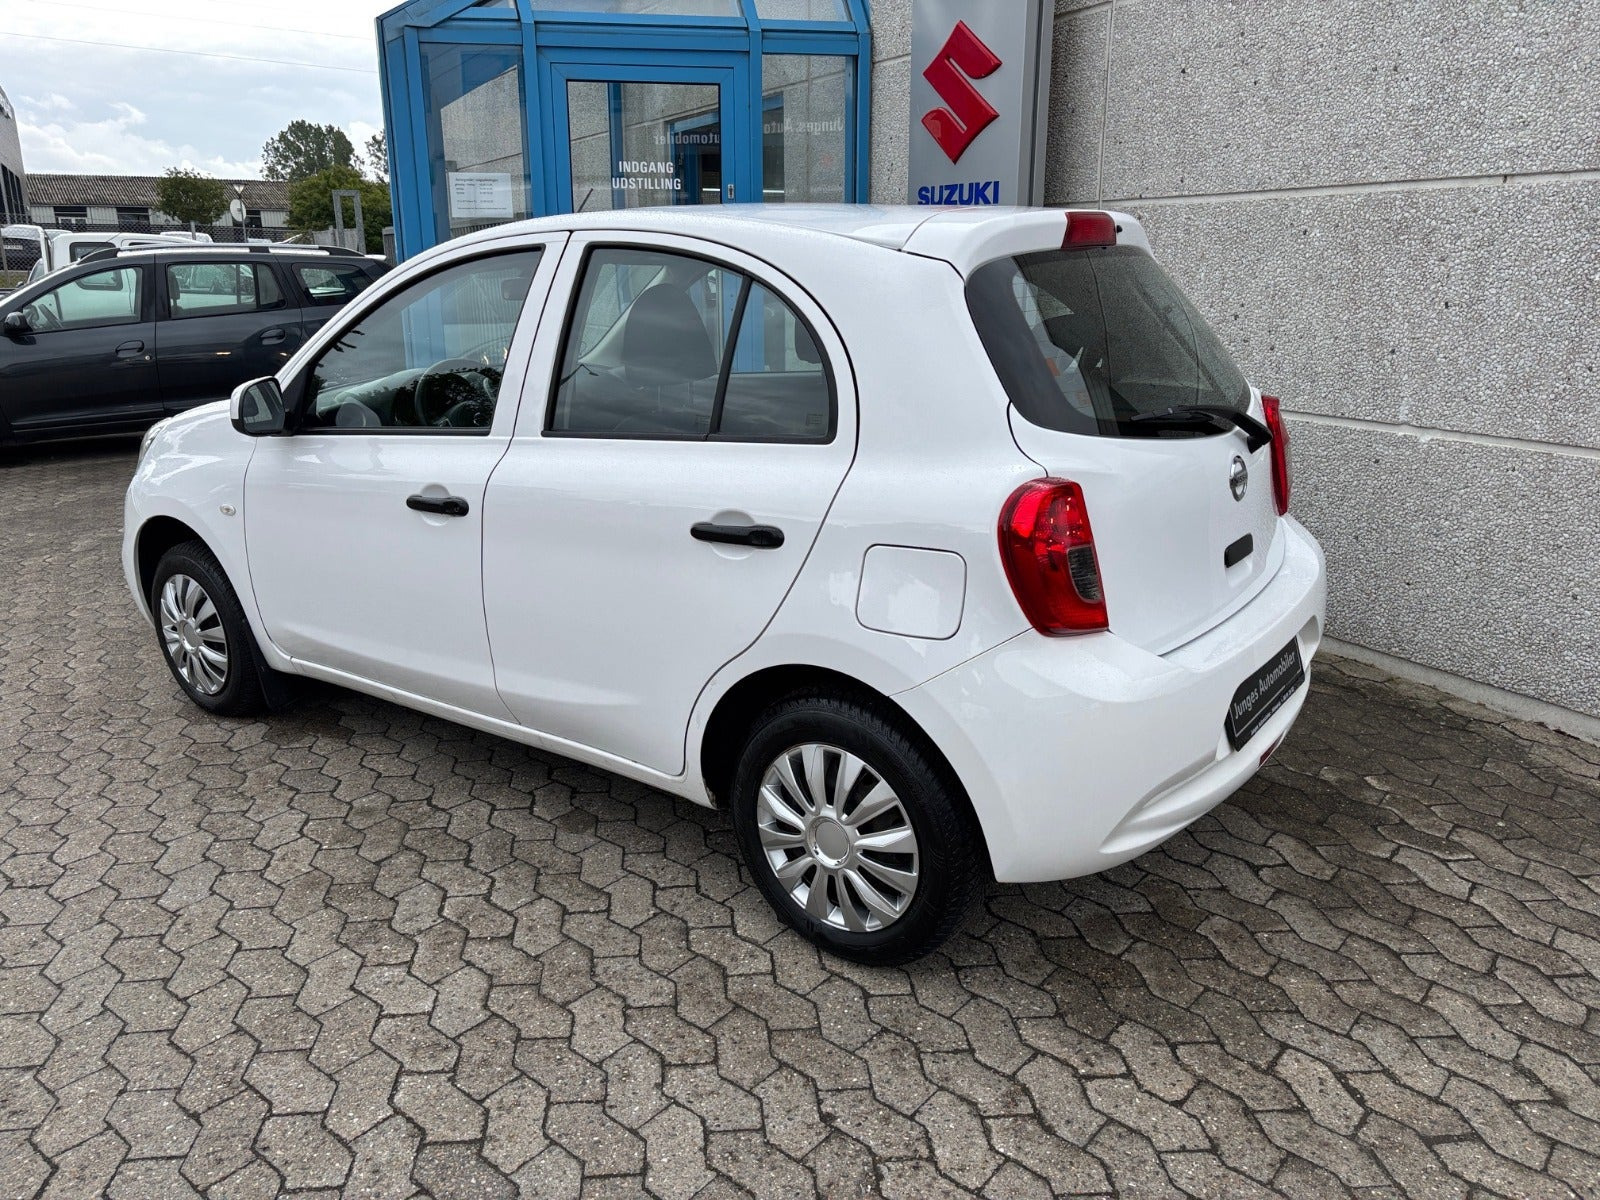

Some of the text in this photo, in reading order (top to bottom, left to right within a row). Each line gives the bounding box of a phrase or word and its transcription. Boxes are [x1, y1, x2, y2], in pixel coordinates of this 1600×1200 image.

[618, 160, 674, 174] INDGANG
[612, 177, 682, 190] UDSTILLING
[917, 180, 1000, 206] SUZUKI
[1234, 688, 1259, 719] Junges
[1259, 652, 1295, 695] Automobiler
